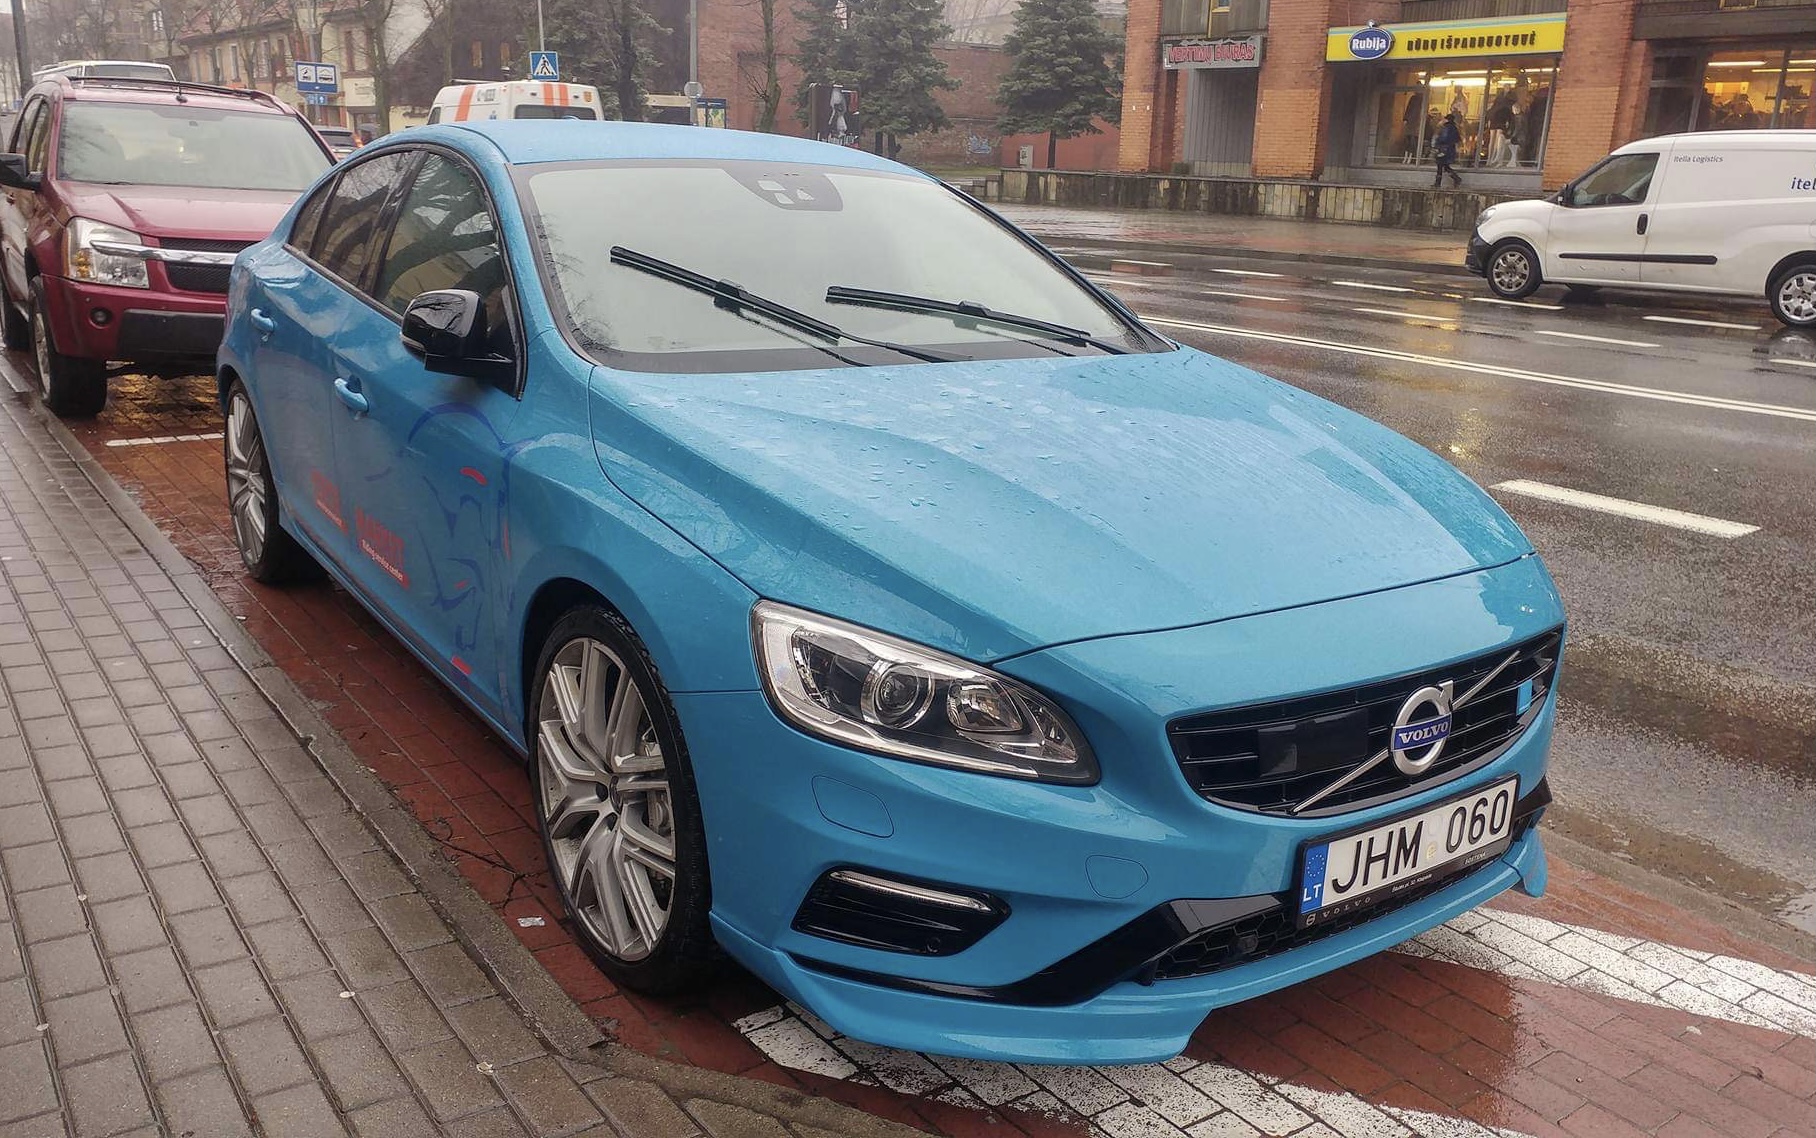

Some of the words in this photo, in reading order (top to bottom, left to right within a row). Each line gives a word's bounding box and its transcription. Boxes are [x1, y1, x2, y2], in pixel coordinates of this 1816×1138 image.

[1352, 38, 1386, 51] Rubija
[1692, 155, 1724, 164] Logistics
[1398, 721, 1449, 744] VOLVO
[1331, 820, 1424, 894] JHM
[1446, 789, 1509, 853] 060
[1303, 883, 1321, 902] LT
[1322, 897, 1371, 918] VOLVO
